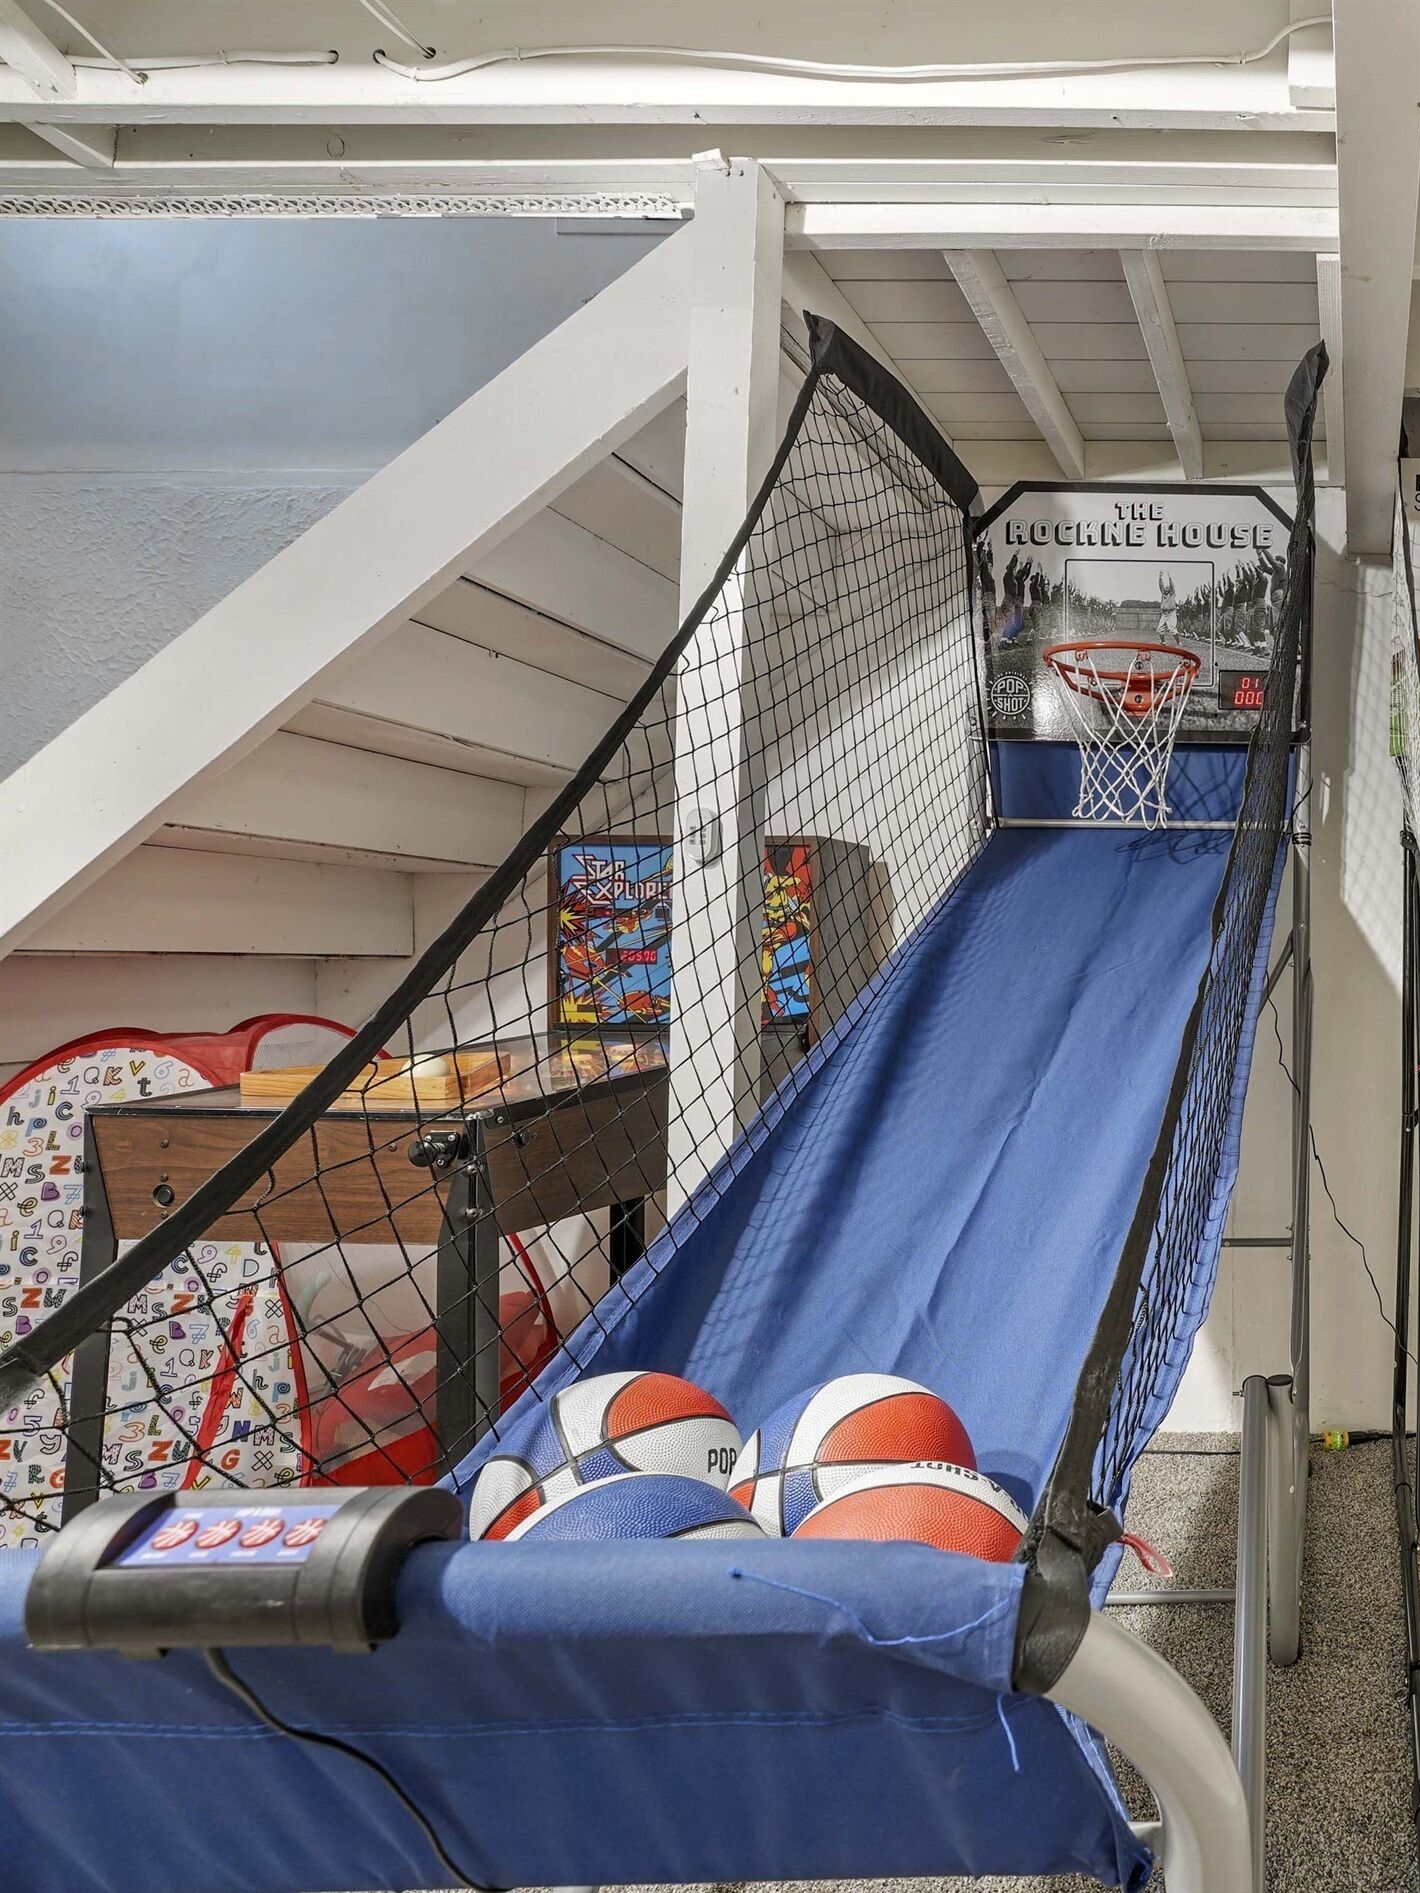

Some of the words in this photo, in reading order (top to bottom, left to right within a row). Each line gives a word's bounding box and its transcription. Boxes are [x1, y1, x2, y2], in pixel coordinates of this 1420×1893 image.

[1114, 502, 1164, 521] THE
[1005, 519, 1147, 547] ROCKNE
[1156, 521, 1275, 549] HOUSE
[996, 678, 1024, 694] POP
[996, 697, 1024, 712] SHOT
[571, 854, 625, 880] STAR
[571, 876, 673, 906] EXPLORE
[103, 1066, 122, 1086] K
[154, 1060, 173, 1079] 6
[61, 1075, 80, 1095] 1
[137, 1077, 152, 1097] t
[6, 1106, 24, 1126] h
[22, 1137, 44, 1157] 3
[1, 1156, 25, 1178] M
[41, 1181, 61, 1201] B
[17, 1197, 38, 1217] e
[24, 1219, 43, 1239] 1
[46, 1234, 67, 1255] 9
[242, 1258, 260, 1277] D
[20, 1287, 42, 1309] Z
[15, 1315, 32, 1336] B
[149, 1335, 168, 1354] e
[160, 1357, 178, 1378] 1
[147, 1440, 173, 1462] Z
[220, 1449, 241, 1470] G
